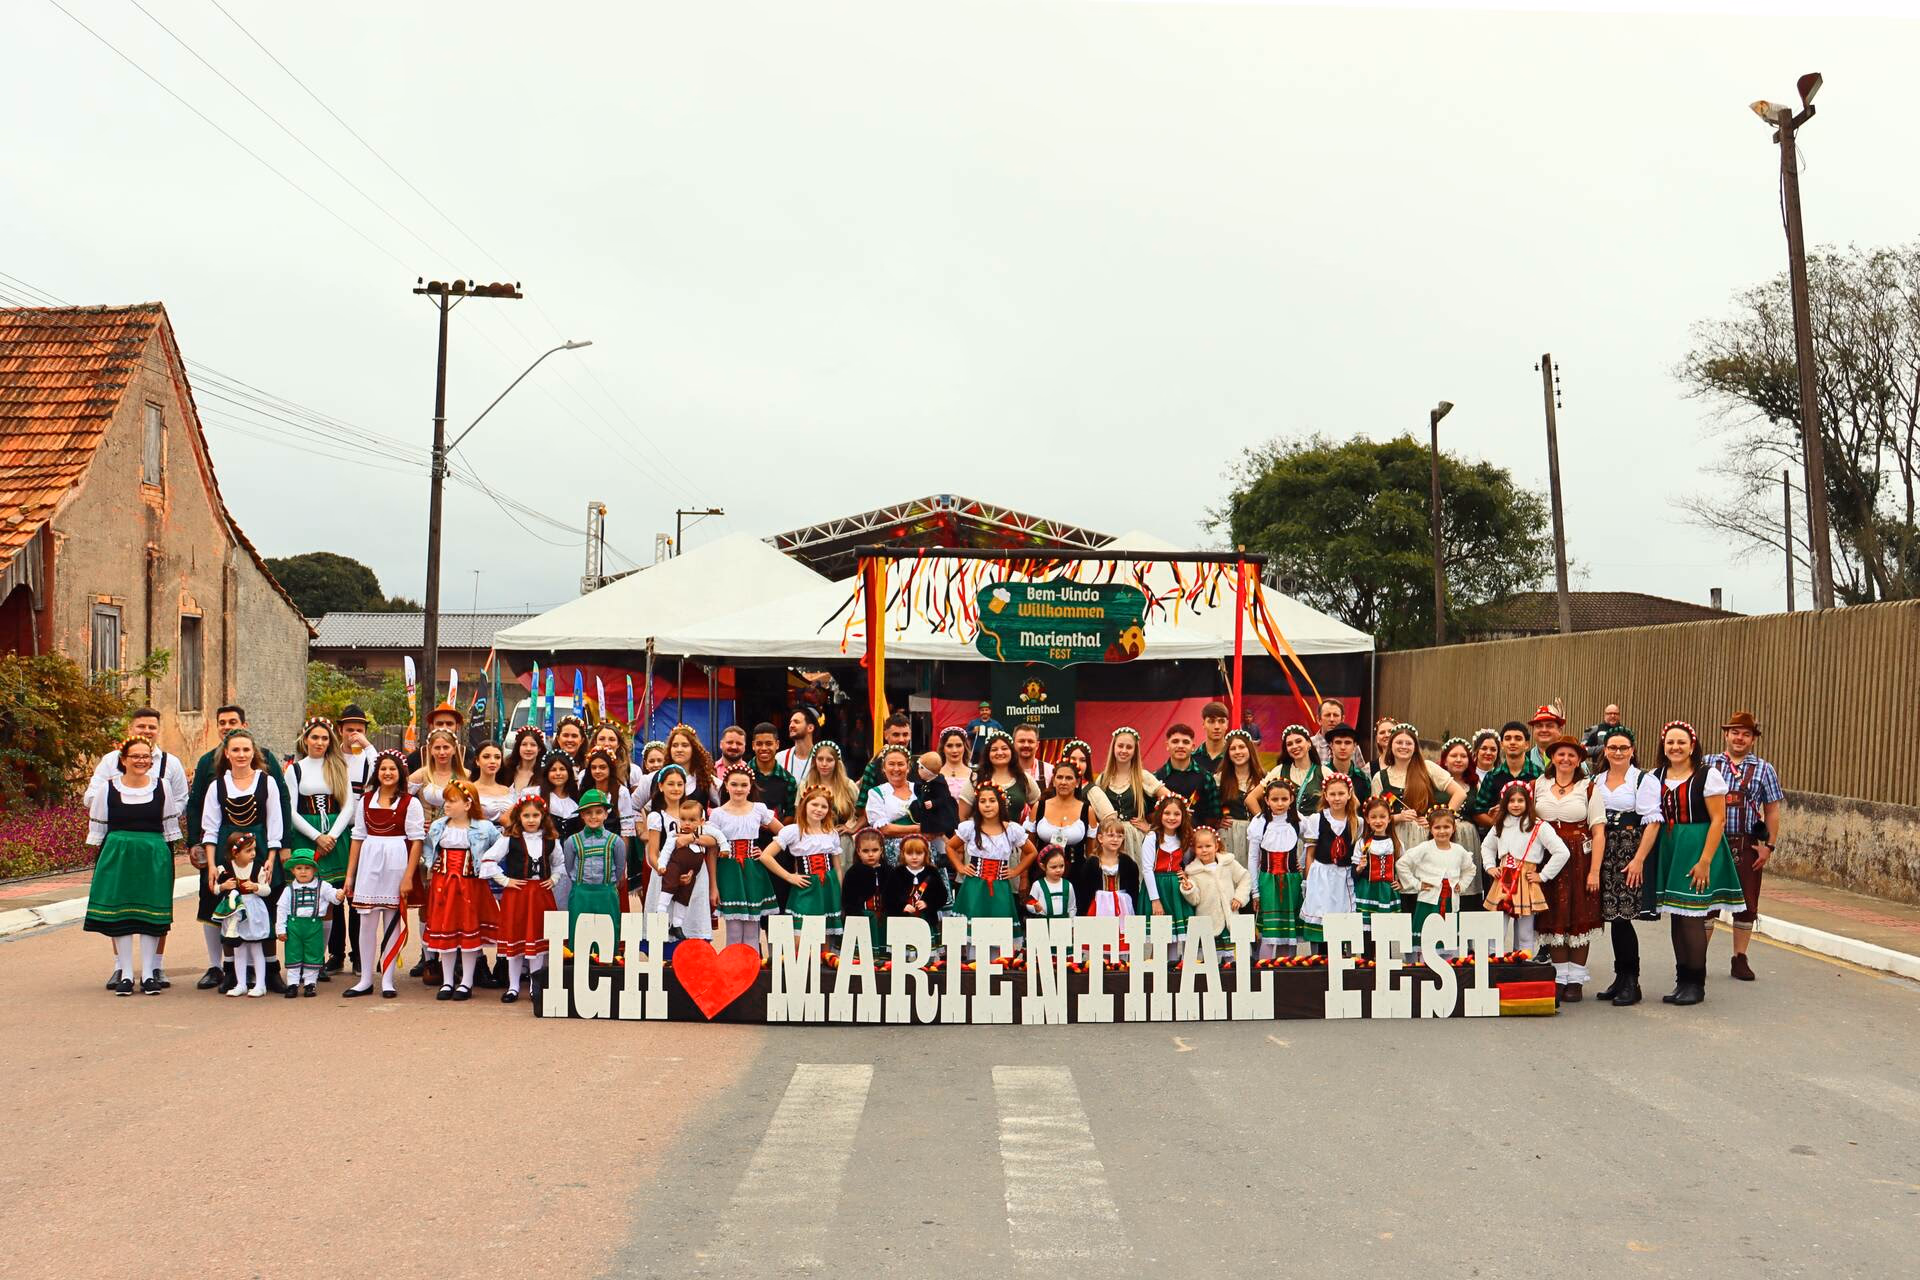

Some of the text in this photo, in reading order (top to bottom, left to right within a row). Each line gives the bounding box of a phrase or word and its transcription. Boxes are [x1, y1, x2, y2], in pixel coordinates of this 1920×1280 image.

[1027, 587, 1100, 601] Bem-Vindo
[1018, 603, 1104, 619] Willkommen
[1020, 631, 1101, 647] Marienthal
[1050, 649, 1071, 659] FEST
[1006, 705, 1060, 715] Marienthal
[542, 910, 1504, 1026] ICH MARIENTHAL FEST
